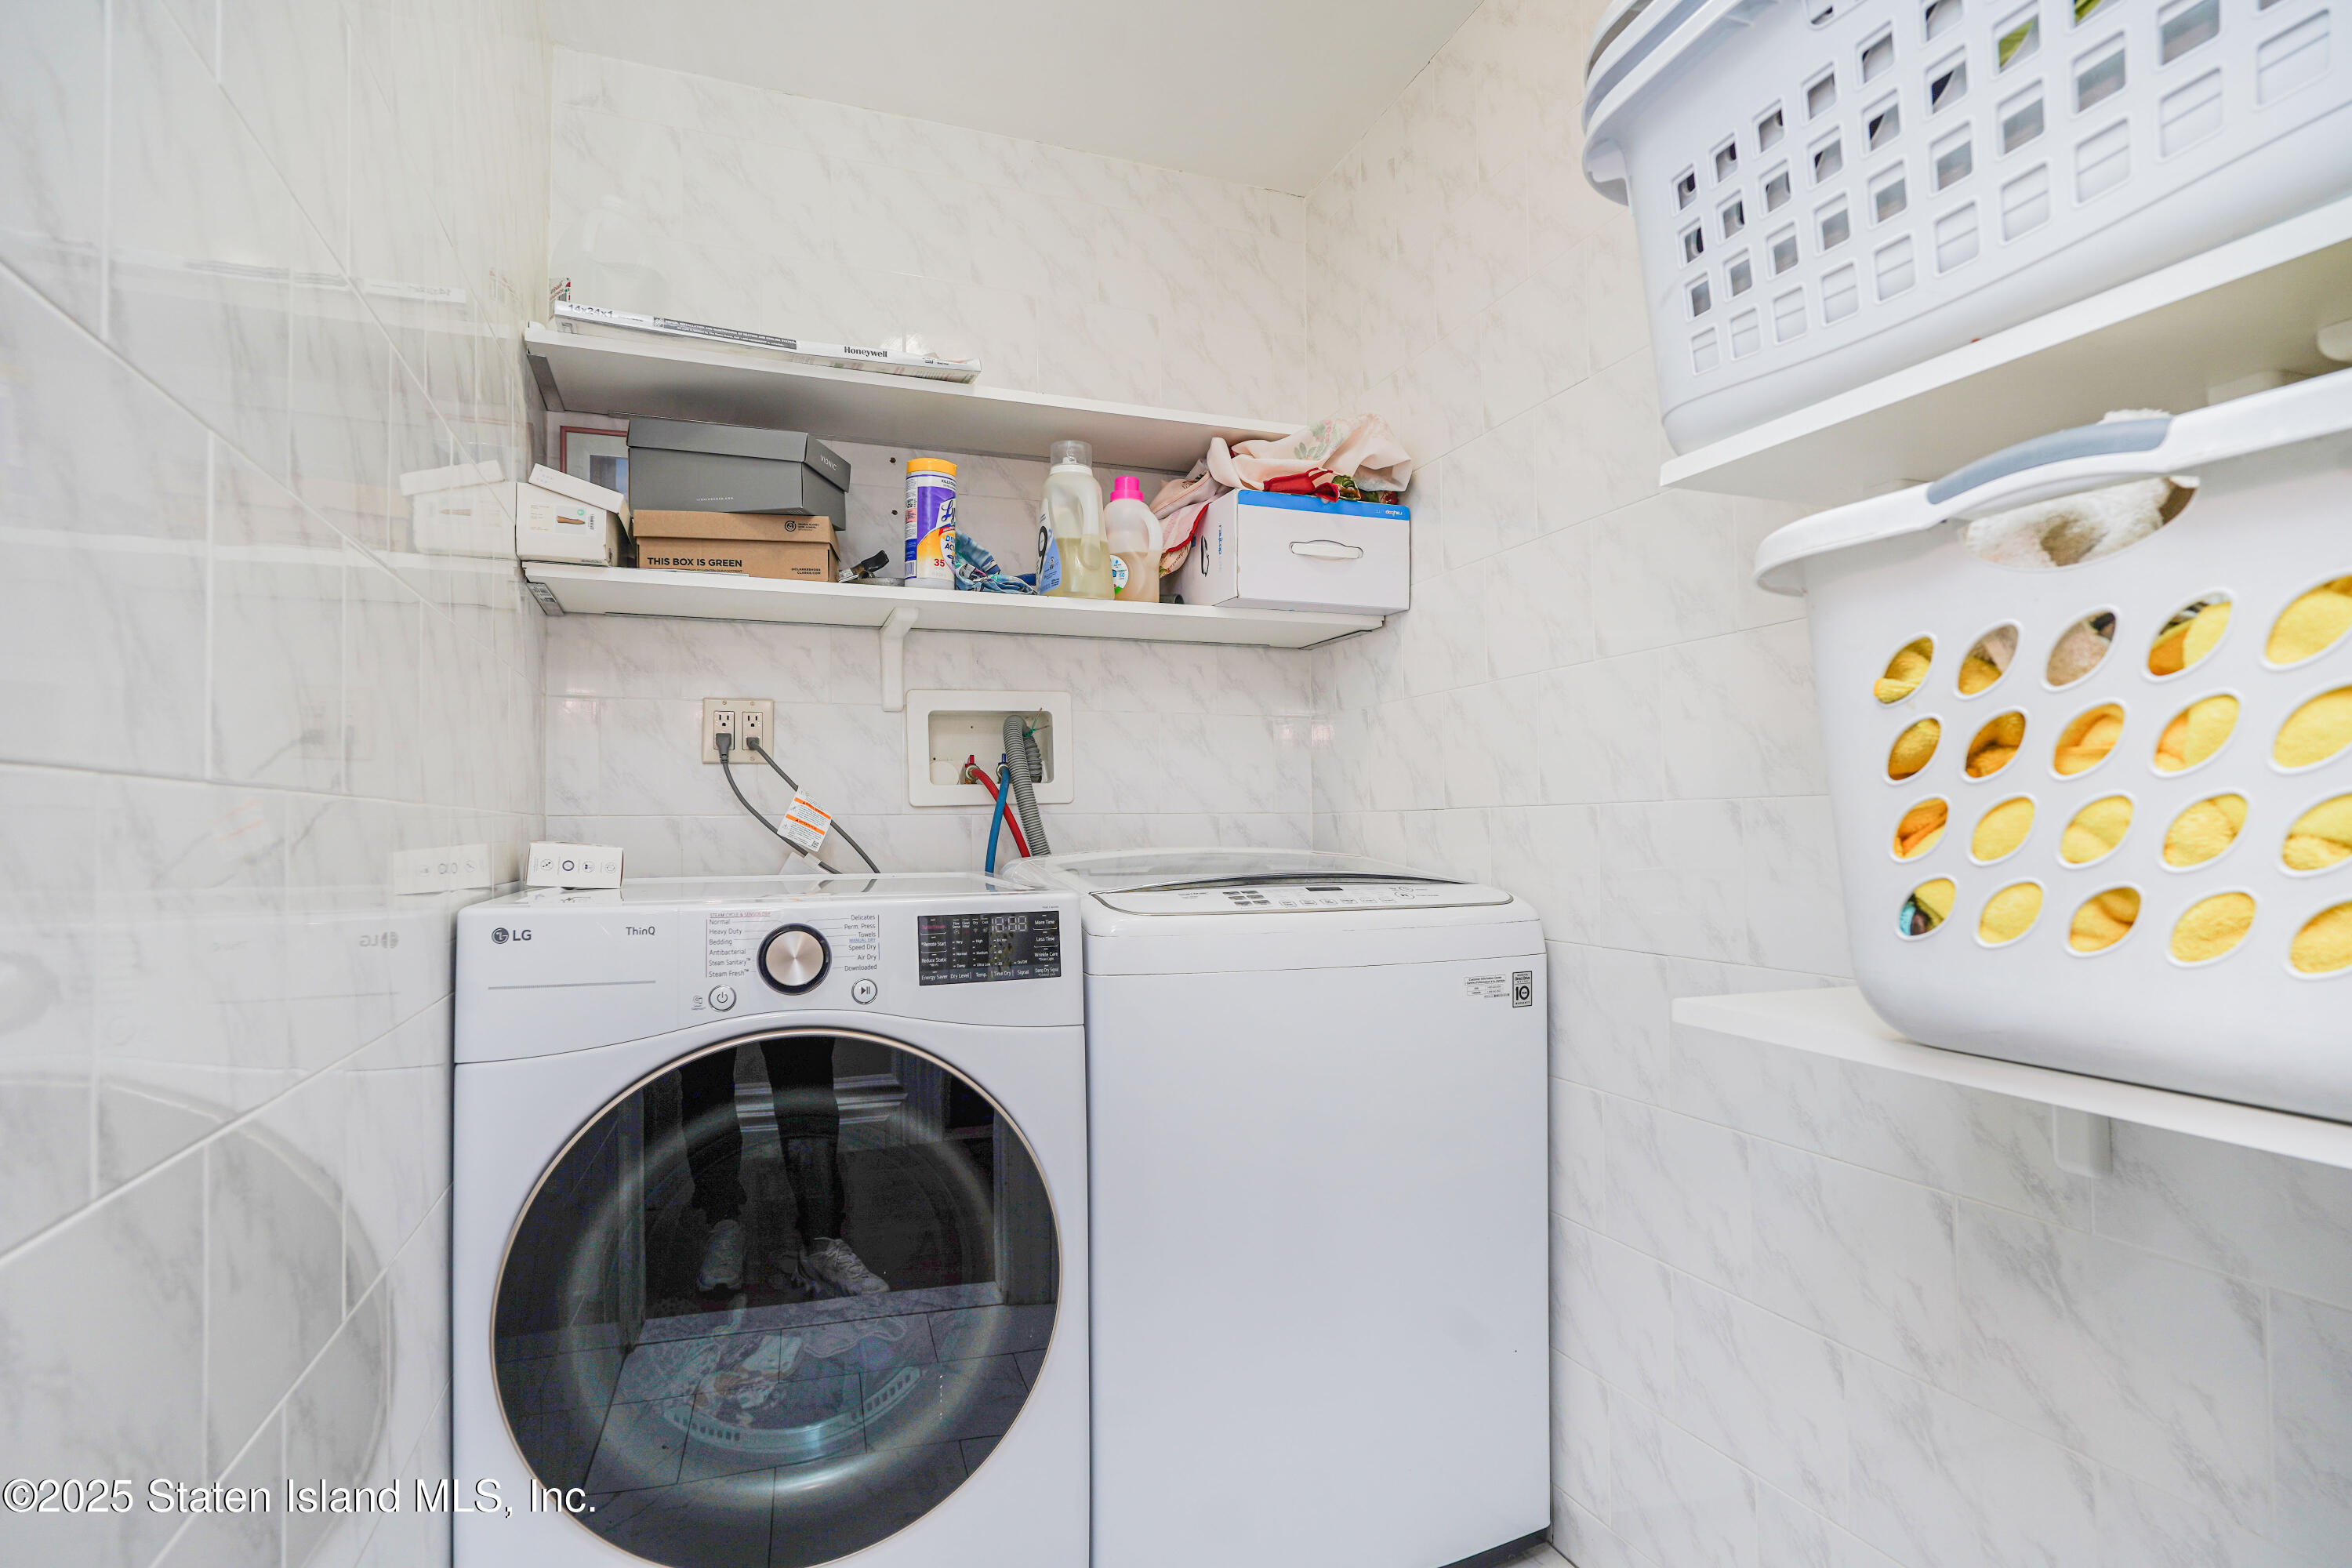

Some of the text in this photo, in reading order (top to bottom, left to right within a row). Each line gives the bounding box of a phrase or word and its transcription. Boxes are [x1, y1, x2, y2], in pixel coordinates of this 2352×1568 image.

[568, 303, 614, 318] 14x24x1
[844, 346, 887, 358] Honeywell
[820, 455, 837, 471] VIONIC
[673, 557, 694, 566] BOX
[934, 558, 946, 568] 35
[512, 930, 532, 941] LG
[625, 926, 655, 936] ThinQ
[1515, 985, 1530, 1000] 10
